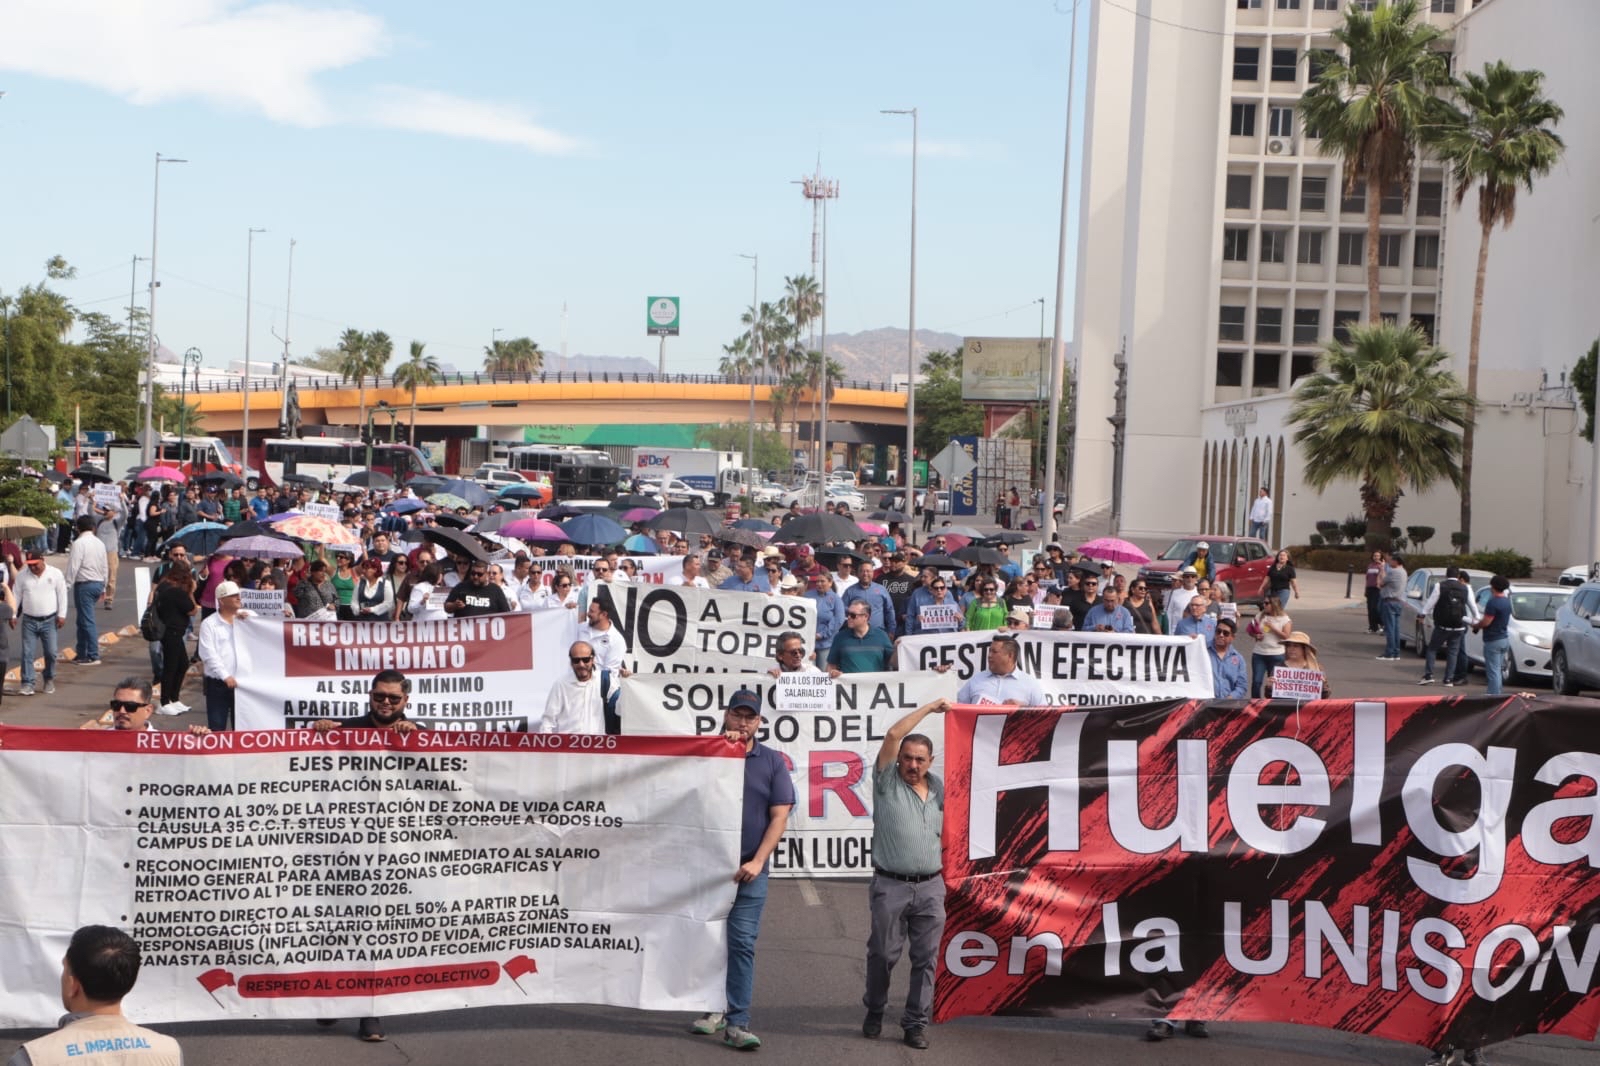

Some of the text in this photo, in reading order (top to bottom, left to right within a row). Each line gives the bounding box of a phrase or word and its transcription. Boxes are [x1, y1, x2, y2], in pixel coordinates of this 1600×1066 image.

[962, 443, 974, 506] GANAR
[274, 592, 282, 600] EN
[292, 617, 506, 646] RECONOCIMIENTO
[597, 584, 807, 657] NO A LOS
[697, 629, 807, 658] TOPE
[335, 644, 466, 670] INMEDIATO
[920, 633, 1190, 682] GESTN EFECTIVA
[316, 675, 484, 695] AL SALO MÍNIMO
[792, 676, 797, 685] A
[798, 676, 810, 685] LOS
[812, 676, 832, 686] TOPES
[1276, 669, 1322, 681] SOLUCIÓN
[284, 700, 294, 716] A
[298, 701, 359, 716] PARTIR
[417, 703, 437, 717] DE
[442, 701, 513, 717] ENERO!!!
[869, 682, 918, 709] AL
[240, 730, 392, 749] CONTRACTUAL
[400, 732, 411, 747] Y
[418, 732, 511, 747] SALARIAL
[569, 735, 617, 749] 2026
[696, 714, 886, 743] PGO DEL
[290, 756, 468, 772] EJES PRINCIPALES:
[139, 776, 462, 797] PROGRAMA DE RECUPERACIÓN SALARIAL.
[138, 798, 606, 820] AUMENTO AL 30% DE LA PRESTACIÓN DE ZONA DE VIDA CARA
[969, 701, 1600, 904] Huelga
[138, 814, 623, 834] CLÁUSULA 35 C.C.T. STEUS Y QUE SE LES OTORGUE A TODOS LOS
[137, 829, 458, 850] CAMPUS DE LA UNIVERSIDAD DE SONORA.
[773, 837, 873, 868] EN LUCH
[136, 848, 600, 872] RECONOCIMIENTO, GESTIÓN Y PAGO INMEDIATO AL SALARIO
[136, 861, 562, 888] MÍNIMO GENERAL PARA AMBAS ZONAS GEOGRAFICAS Y
[135, 887, 250, 903] RETROACTIVO
[253, 887, 272, 900] AL
[292, 884, 312, 897] DE
[316, 883, 367, 897] ENERO
[371, 883, 412, 896] 2026.
[134, 894, 560, 925] AUMENTO DIRECTO AL SALARIO DEL 50% A PARTIR DE LA
[133, 909, 569, 939] HOMOLOGACIÓN DEL SALARIO MÍNIMO DE AMBAS ZONAS
[258, 932, 348, 952] (INFLACIÓN
[352, 934, 362, 946] Y
[366, 932, 418, 946] COSTO
[422, 930, 440, 943] DE
[444, 928, 484, 941] VIDA,
[488, 922, 589, 938] CRECIMIENTO
[592, 924, 611, 935] EN
[140, 936, 645, 967] ANASTA BÁSICA, AQUIDA TA MA UDA FECOEMIC FUSIAD SALARIAL).
[945, 899, 1600, 1004] en la UNISON
[245, 968, 490, 992] RESPETO AL CONTRATO COLECTIVO
[66, 1037, 151, 1056] EL IMPARCIAL
